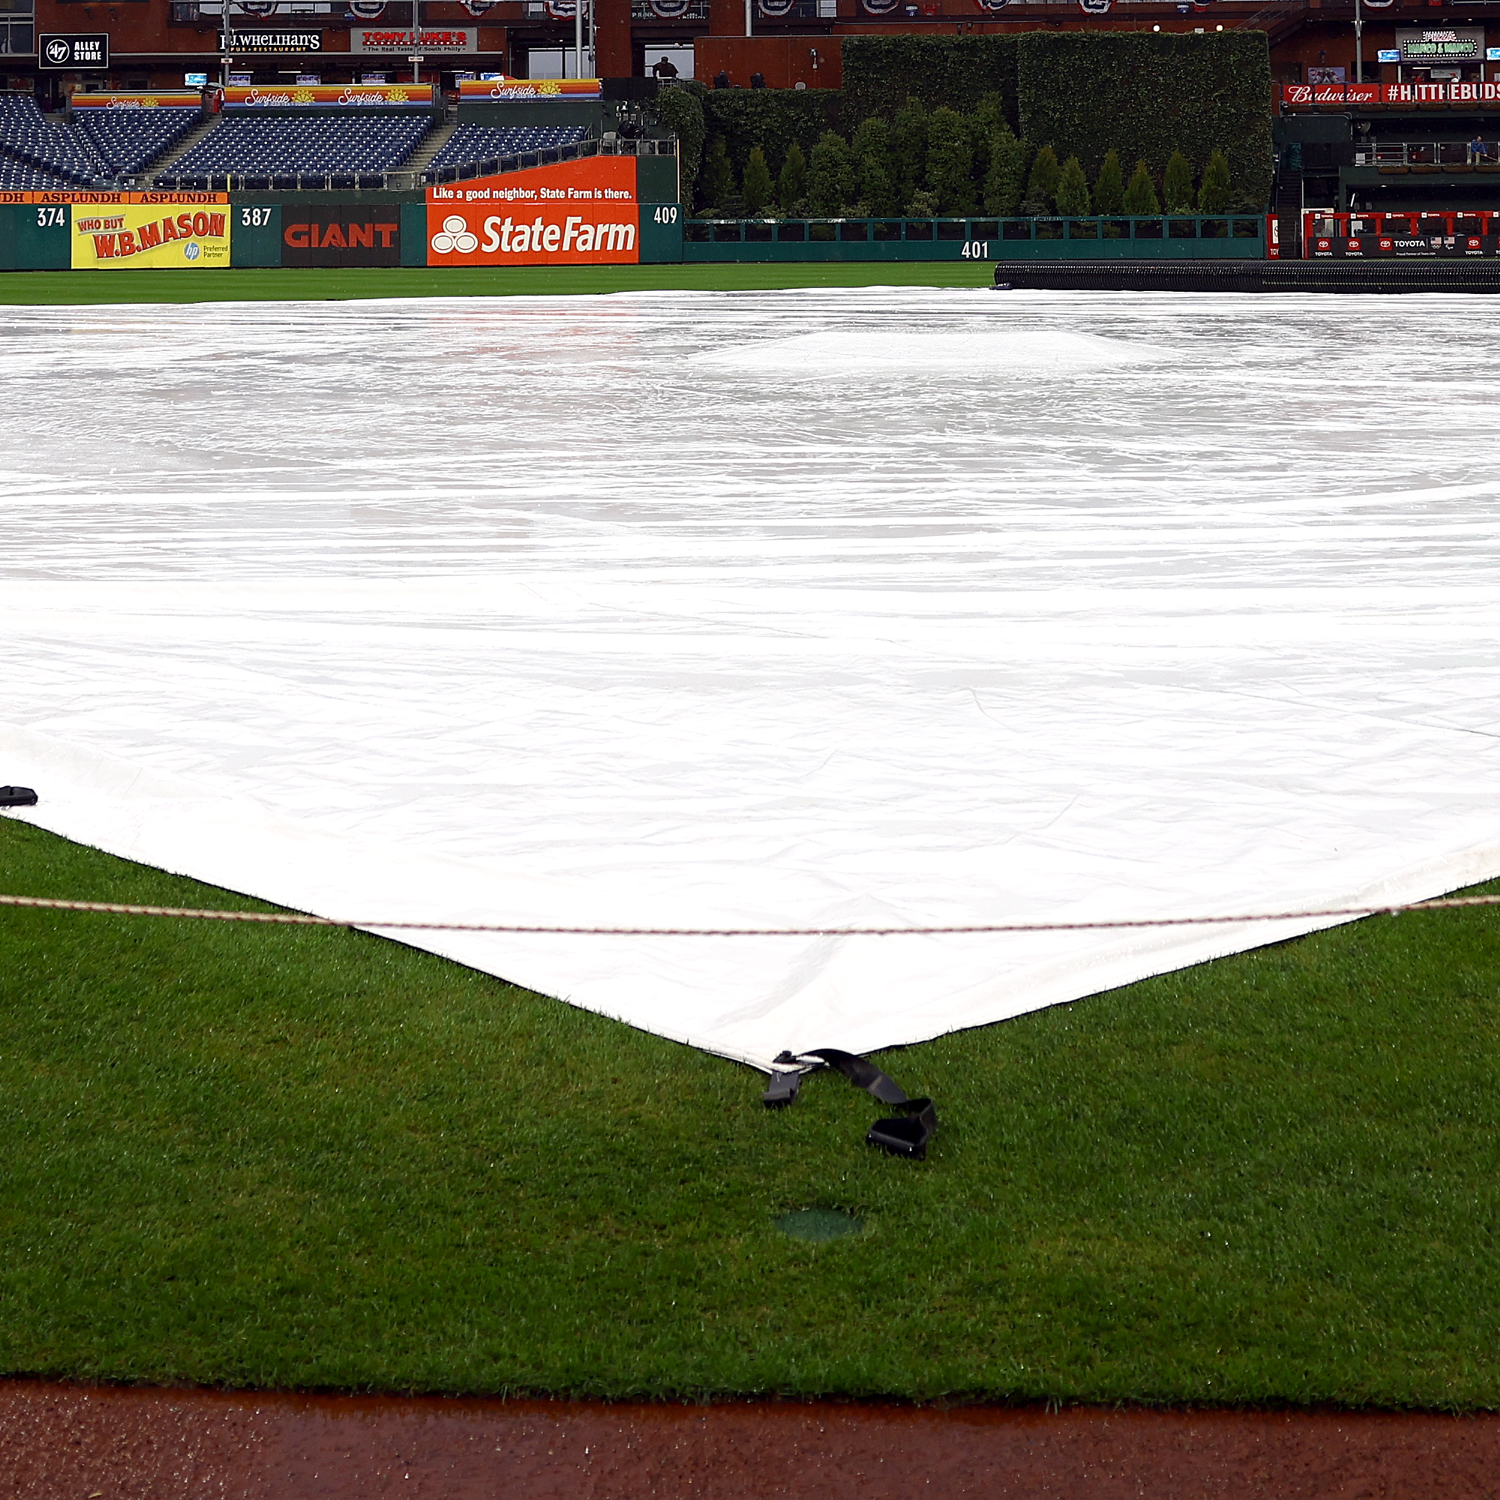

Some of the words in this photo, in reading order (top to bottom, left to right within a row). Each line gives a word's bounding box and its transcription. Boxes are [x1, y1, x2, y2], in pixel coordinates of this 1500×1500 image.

[362, 32, 406, 41] TONY
[74, 41, 100, 51] ALLEY
[74, 51, 102, 61] STORE
[245, 88, 290, 107] Surfside
[338, 88, 383, 106] Surfside
[1288, 85, 1373, 103] Budweiser
[433, 187, 454, 199] Like
[456, 190, 463, 199] a
[465, 188, 490, 201] good
[492, 187, 538, 201] neighbor,
[540, 188, 565, 199] State
[568, 188, 592, 199] Farm
[594, 188, 602, 199] is
[604, 188, 632, 199] there.
[37, 208, 66, 227] 374
[241, 208, 271, 227] 387
[654, 206, 678, 224] 409
[77, 218, 101, 232] WHO
[103, 217, 124, 230] BUT
[283, 223, 398, 248] GIANT
[481, 216, 560, 253] State
[561, 216, 635, 251] Farm
[185, 244, 199, 260] hp
[961, 241, 989, 259] 401
[1394, 240, 1425, 248] TOYOTA
